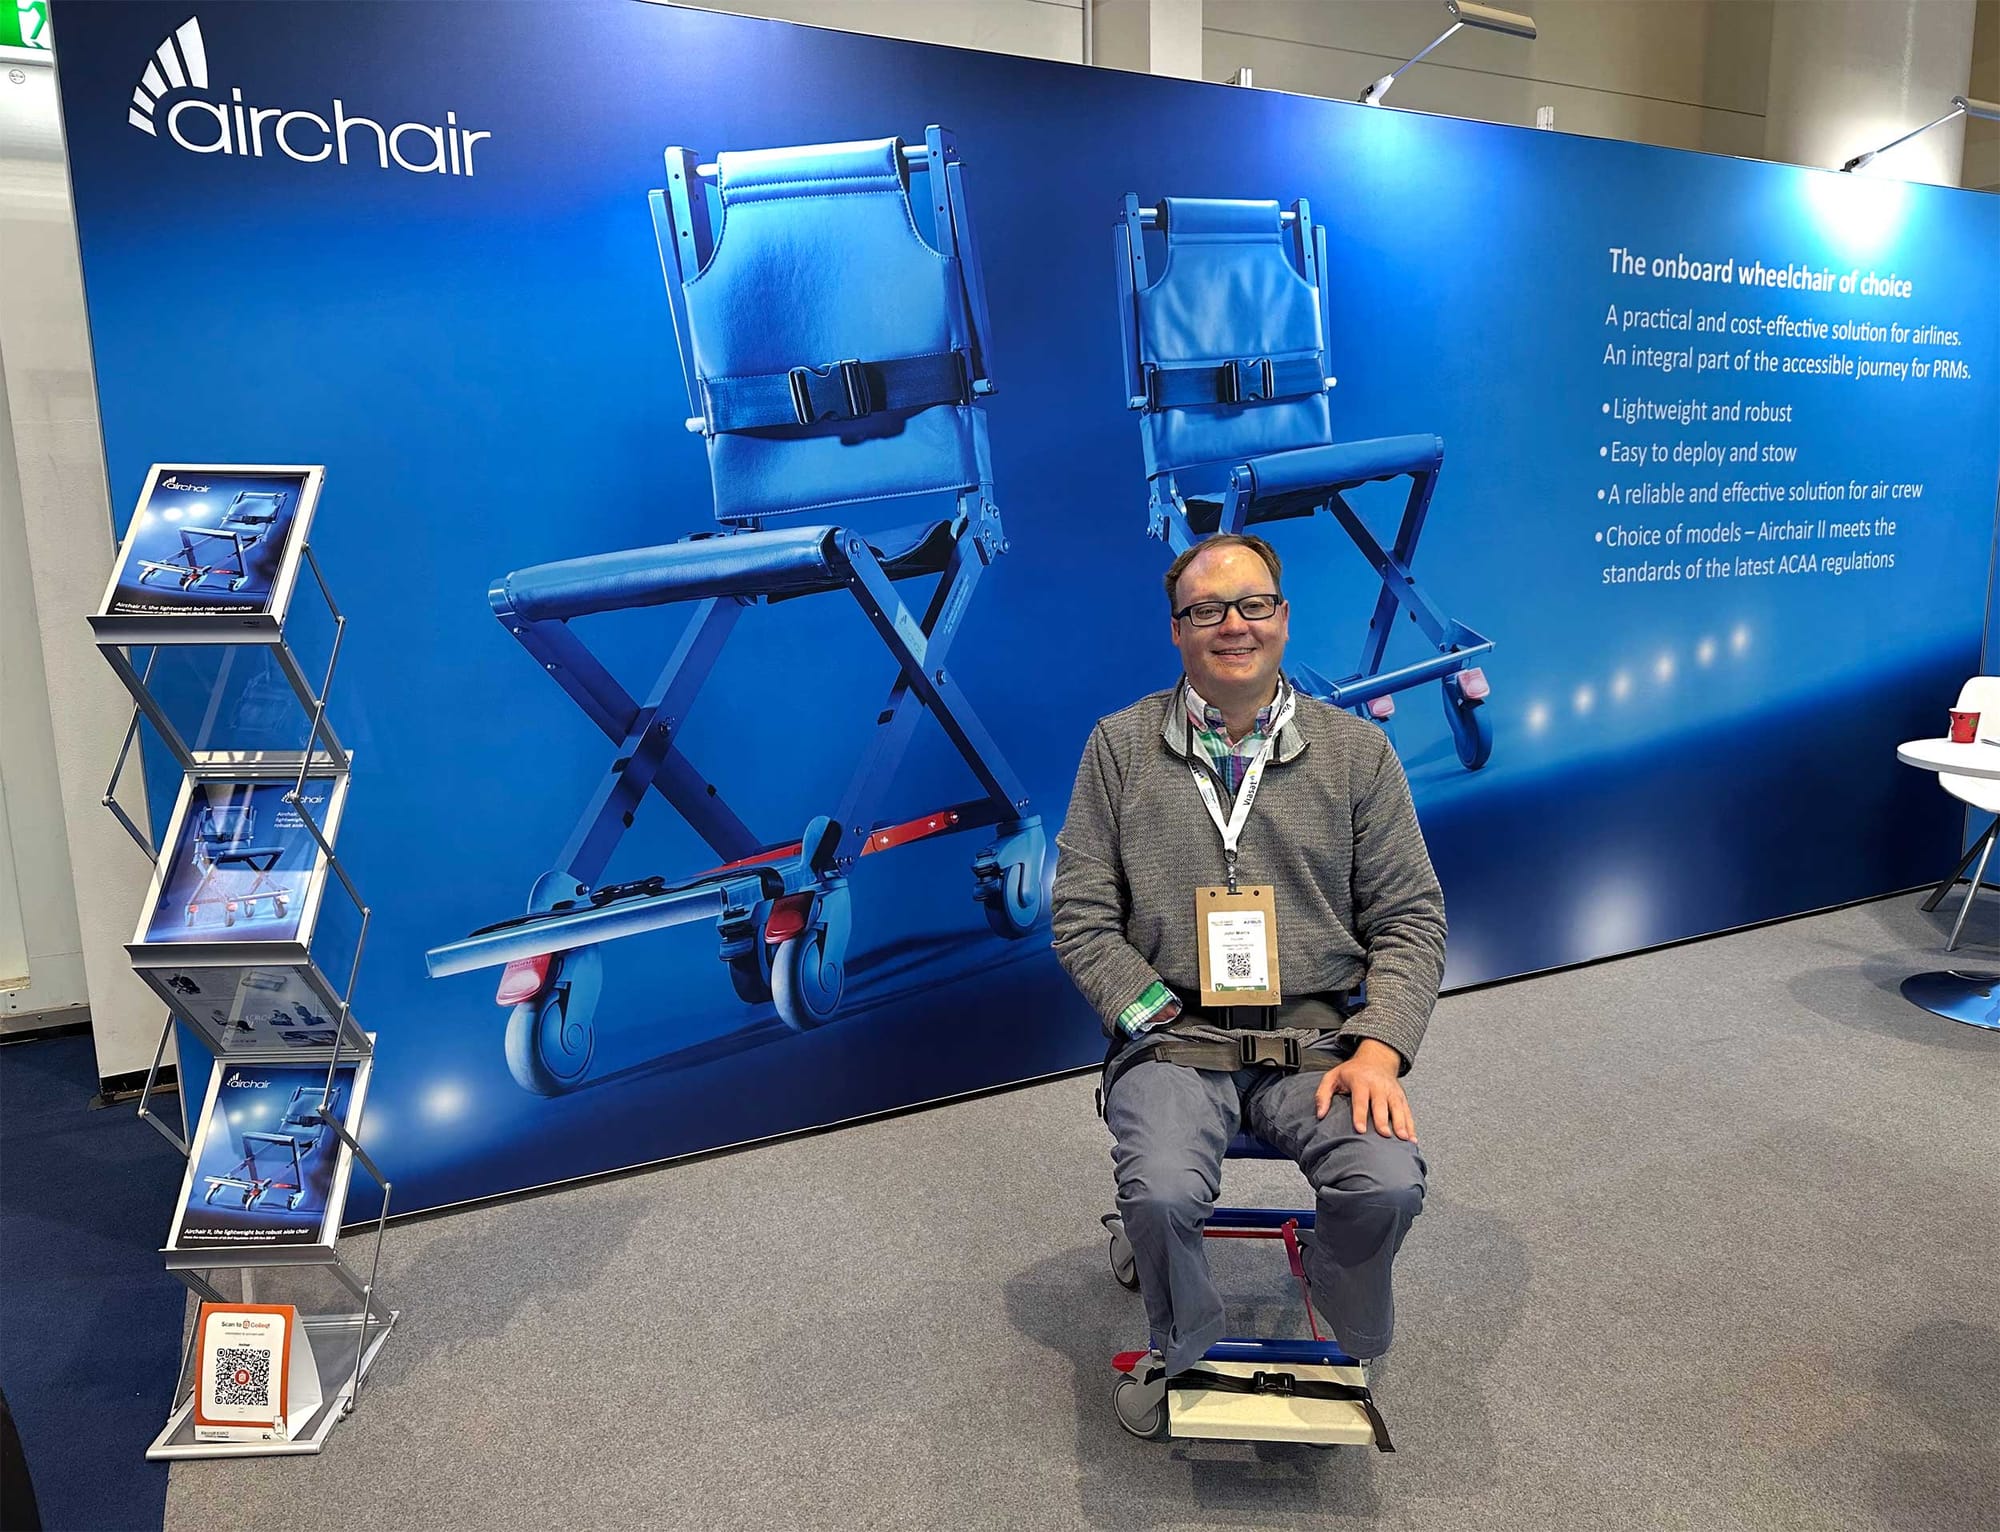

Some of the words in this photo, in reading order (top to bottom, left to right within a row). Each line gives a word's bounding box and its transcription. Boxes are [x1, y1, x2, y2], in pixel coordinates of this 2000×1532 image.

[167, 87, 491, 177] airchair
[1609, 248, 1646, 275] The
[1652, 253, 1733, 283] onboard
[1738, 260, 1836, 292] wheelchair
[1839, 269, 1857, 293] of
[1860, 271, 1912, 298] choice
[1605, 304, 1618, 326] A
[1623, 308, 1692, 332] practical
[1697, 311, 1726, 332] and
[1731, 315, 1828, 339] cost-effective
[1832, 320, 1886, 341] solution
[1891, 322, 1908, 343] for
[1912, 325, 1961, 345] airlines.
[1603, 343, 1626, 366] An
[1632, 344, 1693, 372] integral
[1697, 351, 1730, 373] part
[1734, 349, 1751, 371] of
[1754, 350, 1778, 372] the
[1782, 354, 1853, 375] accessible
[1855, 356, 1908, 382] journey
[1912, 357, 1930, 378] for
[1933, 359, 1971, 379] PRMs.
[1614, 397, 1708, 425] Lightweight
[1711, 400, 1740, 422] and
[1745, 401, 1792, 422] robust
[1611, 441, 1647, 467] Easy
[1652, 443, 1668, 462] to
[1673, 440, 1726, 467] deploy
[1729, 441, 1758, 462] and
[1762, 444, 1797, 462] stow
[166, 482, 211, 493] airchair
[1608, 484, 1620, 505] A
[1625, 482, 1685, 504] reliable
[1689, 482, 1718, 503] and
[1722, 481, 1785, 502] effective
[1788, 480, 1844, 501] solution
[1849, 480, 1868, 500] for
[1871, 480, 1888, 499] air
[1892, 483, 1923, 499] crew
[1606, 525, 1661, 547] Choice
[1665, 522, 1683, 545] of
[1686, 521, 1741, 544] models
[1757, 520, 1814, 541] Airchair
[1817, 520, 1826, 539] II
[1829, 521, 1871, 538] meets
[1874, 516, 1896, 536] the
[1602, 560, 1681, 584] standards
[1685, 558, 1703, 579] of
[1705, 557, 1730, 579] the
[1734, 556, 1775, 577] latest
[1778, 554, 1818, 575] ACAA
[1821, 550, 1895, 575] regulations
[231, 1079, 272, 1089] airchair
